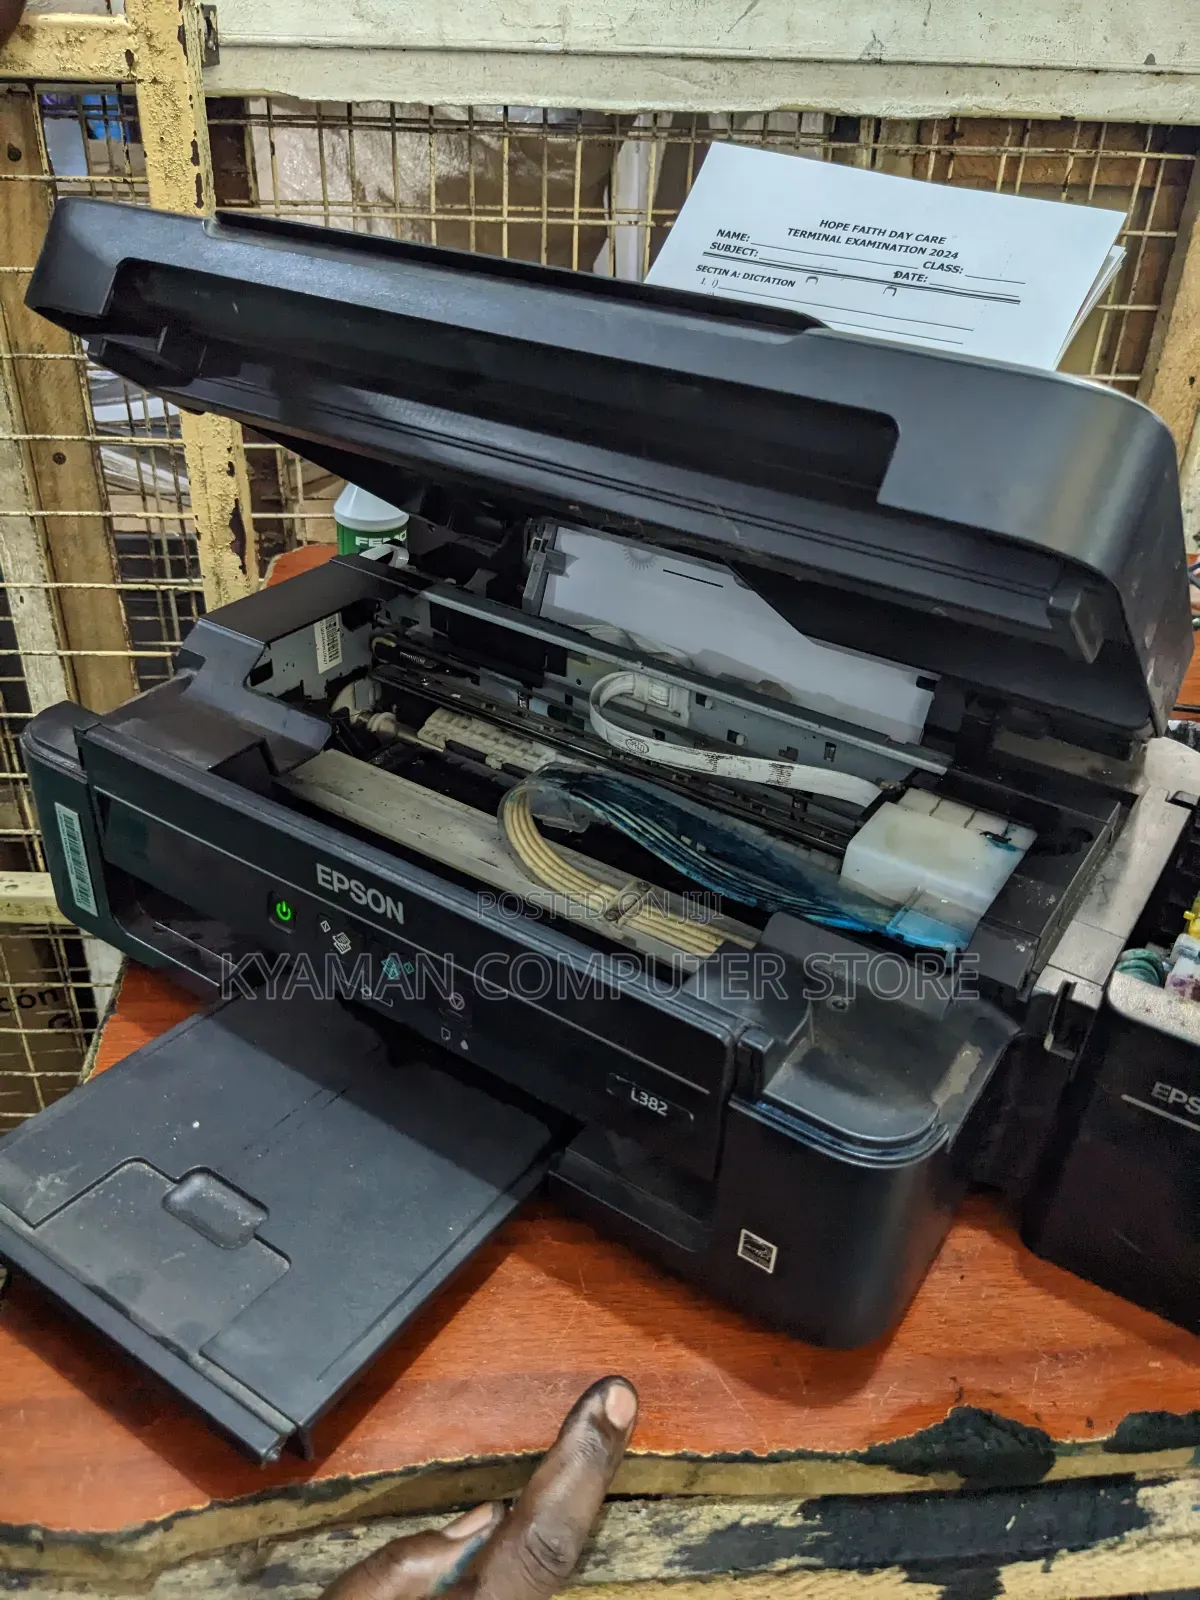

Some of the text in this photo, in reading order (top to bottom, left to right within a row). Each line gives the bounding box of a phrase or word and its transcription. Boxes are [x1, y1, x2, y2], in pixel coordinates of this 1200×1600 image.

[716, 229, 751, 242] NAME:
[787, 227, 960, 260] TERMINAL EXAMINATION 2024
[819, 219, 947, 245] HOPE FAITH DAY CARE
[709, 241, 759, 258] SUBJECT:
[695, 264, 730, 278] SECTIN
[742, 272, 797, 288] DICTATION
[922, 261, 964, 275] CLASS:
[316, 863, 404, 925] EPSON
[630, 1086, 668, 1117] L382
